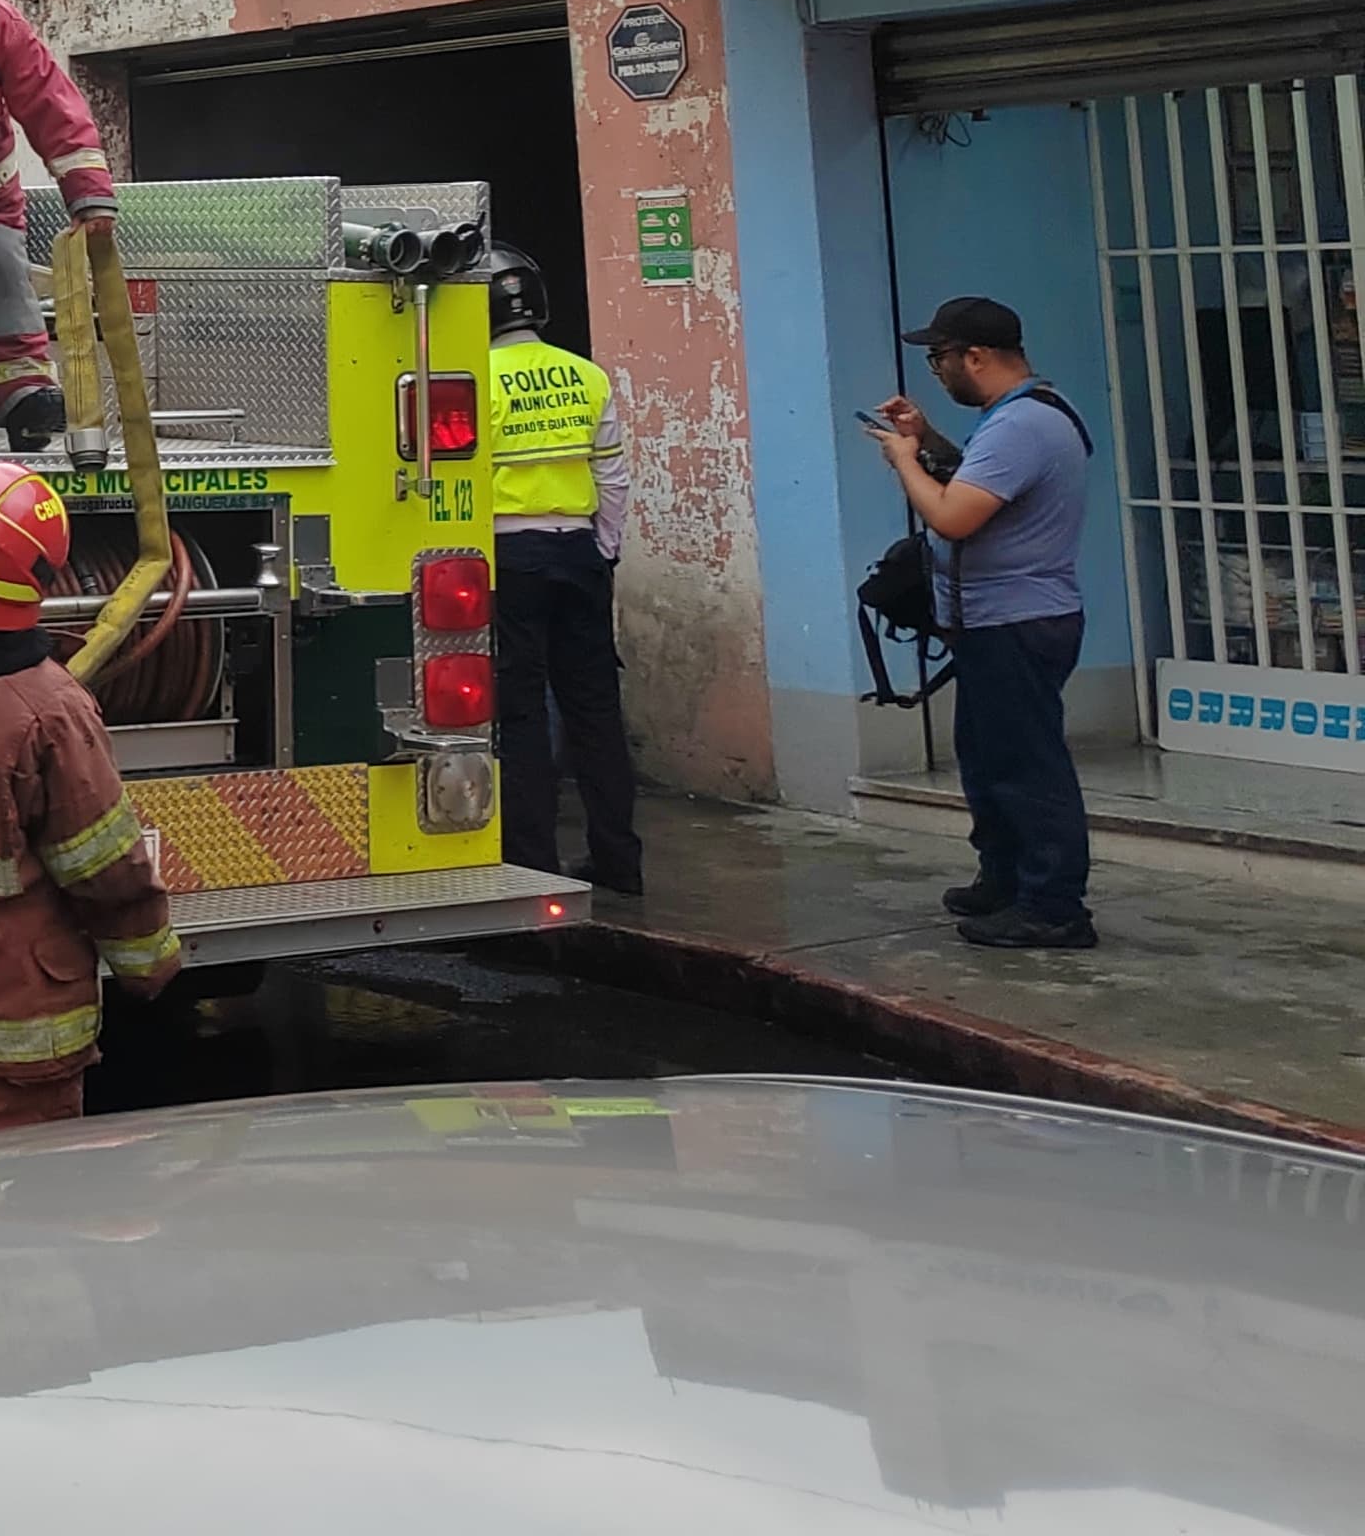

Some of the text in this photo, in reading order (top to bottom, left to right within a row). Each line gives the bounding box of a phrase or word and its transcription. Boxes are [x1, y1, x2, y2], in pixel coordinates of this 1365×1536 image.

[622, 14, 667, 28] PROTEGE
[499, 365, 584, 396] POLICIA
[510, 390, 590, 414] MUNICIPAL
[502, 420, 536, 437] CIUDAD
[548, 415, 594, 431] GUATEMAL
[97, 467, 268, 496] MUCIPALES
[454, 479, 473, 522] 123
